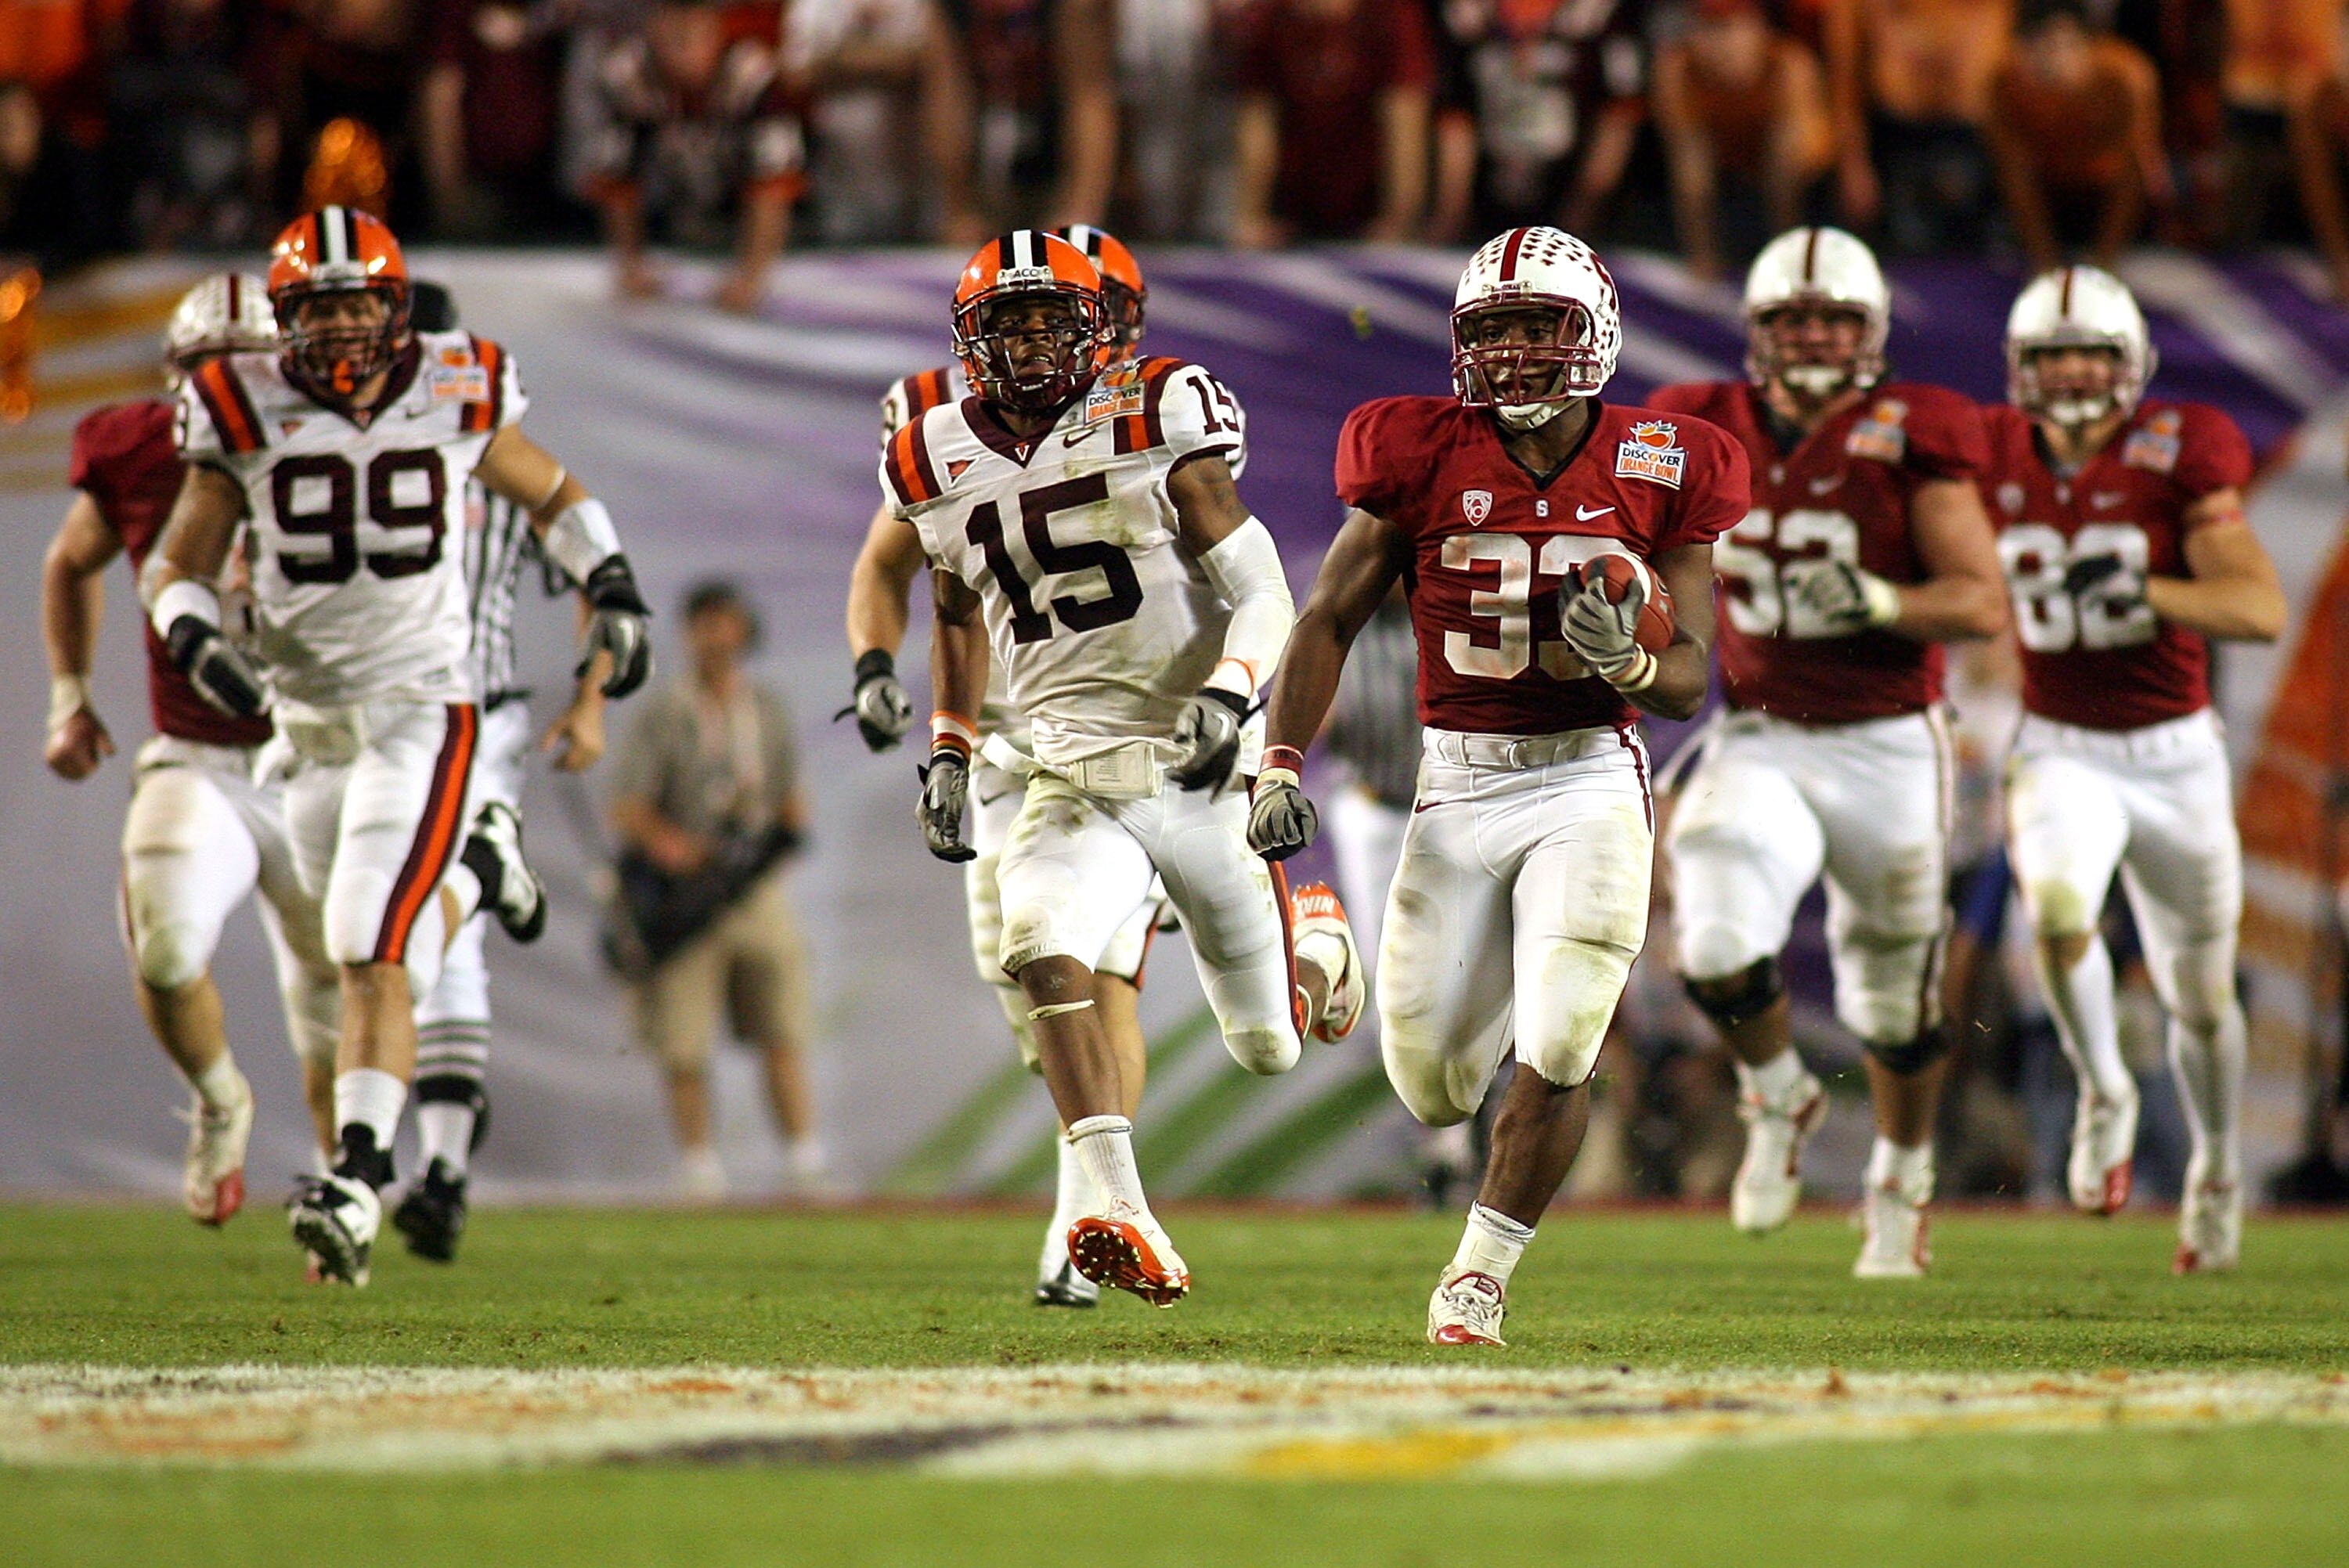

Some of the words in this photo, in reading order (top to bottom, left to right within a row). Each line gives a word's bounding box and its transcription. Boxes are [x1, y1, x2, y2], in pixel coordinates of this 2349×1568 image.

[1012, 268, 1040, 278] ACC
[1186, 373, 1240, 436] 15
[1620, 457, 1654, 475] ORANGE
[1654, 463, 1679, 482] BOWL
[1622, 447, 1680, 466] DISCOVER
[271, 448, 447, 584] 99
[1535, 499, 1549, 517] S
[965, 472, 1144, 644] 15
[1997, 523, 2155, 654] 82
